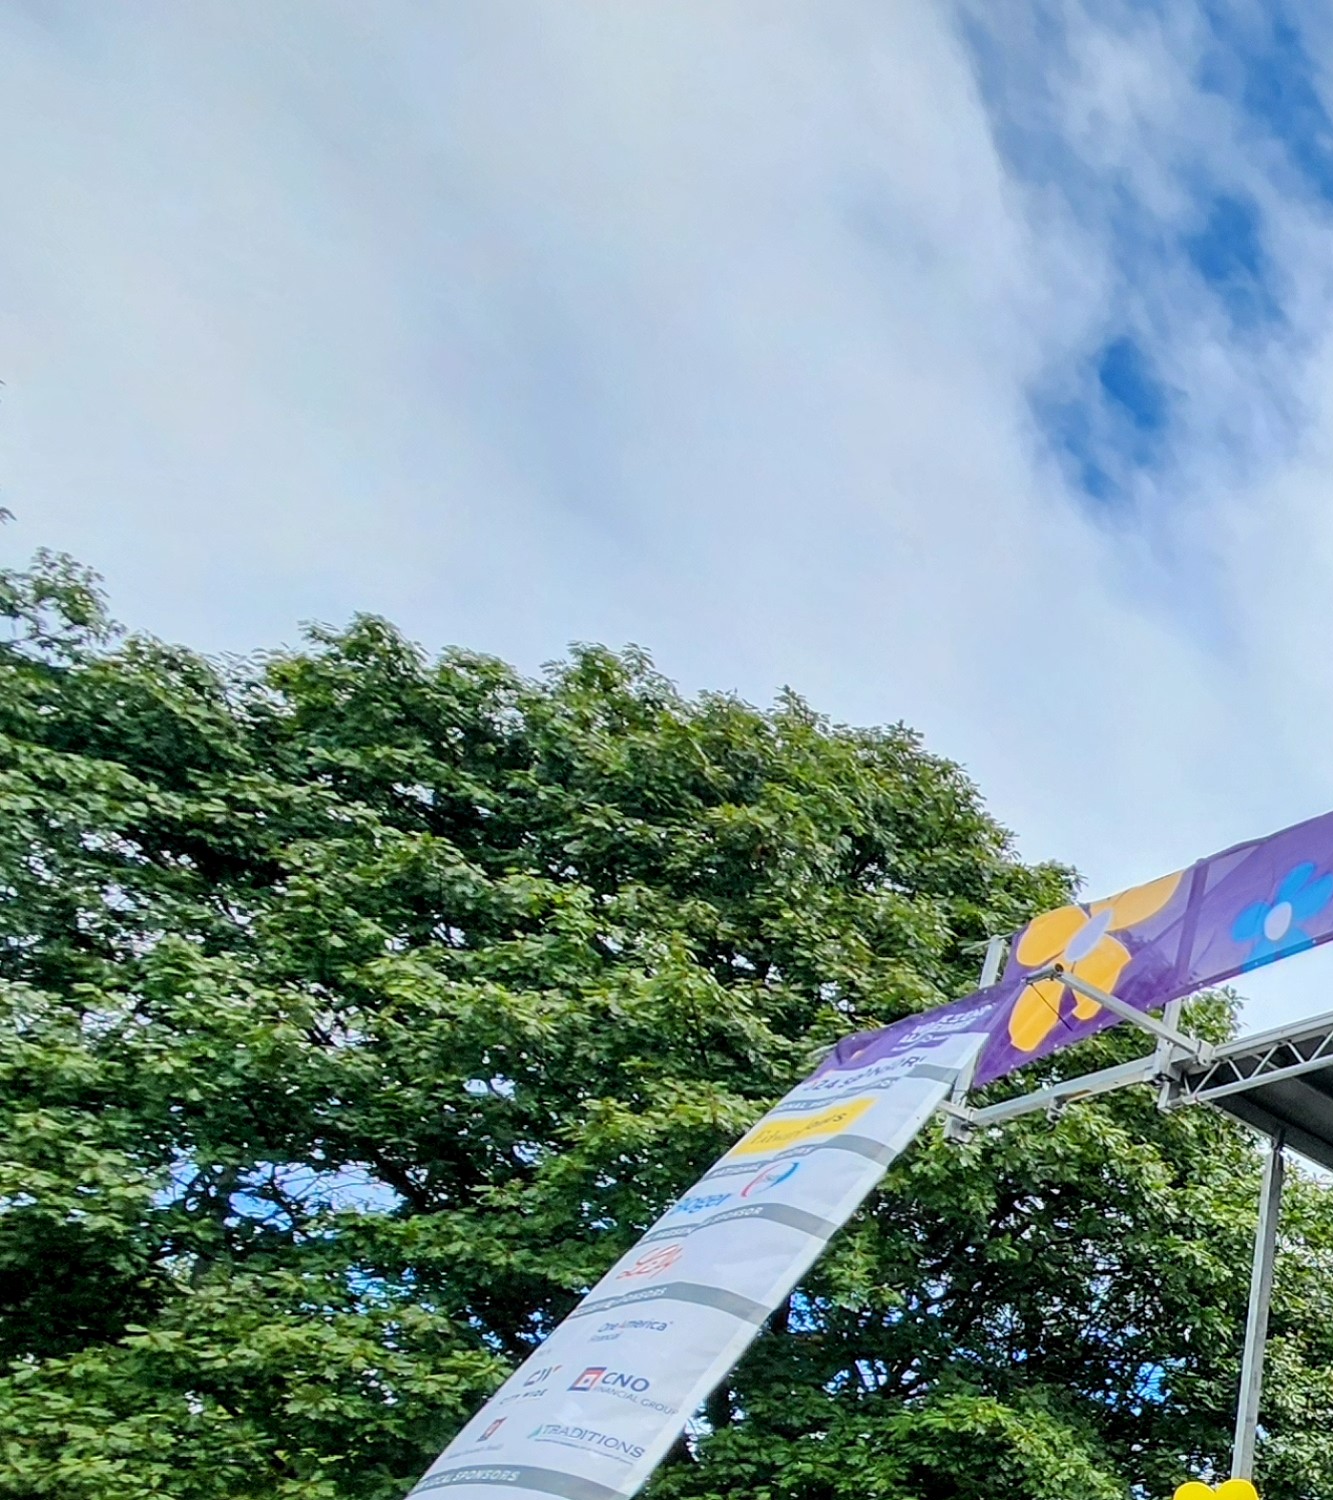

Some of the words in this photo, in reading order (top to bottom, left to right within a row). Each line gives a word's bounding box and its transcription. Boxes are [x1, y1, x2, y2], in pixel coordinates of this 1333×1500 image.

[600, 1371, 650, 1393] CNO
[640, 1398, 679, 1417] GROUP
[542, 1424, 646, 1459] TRADITIONS
